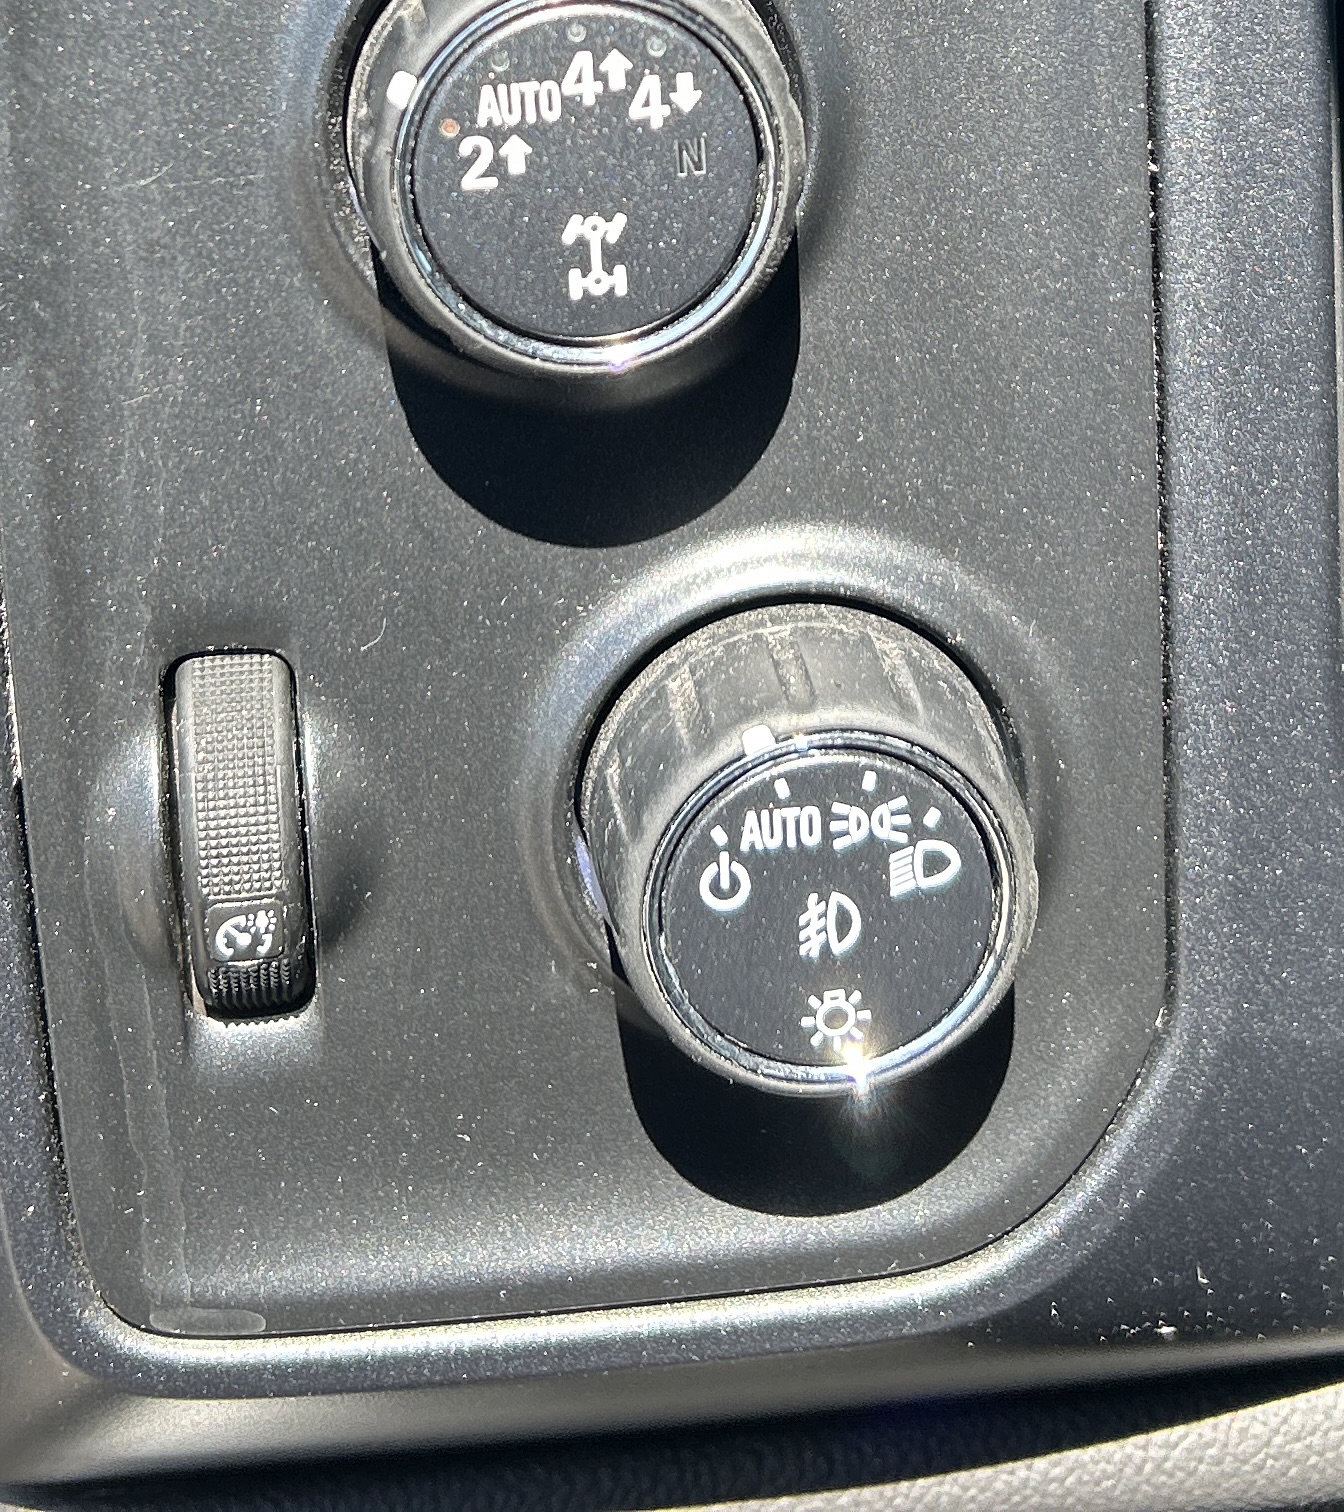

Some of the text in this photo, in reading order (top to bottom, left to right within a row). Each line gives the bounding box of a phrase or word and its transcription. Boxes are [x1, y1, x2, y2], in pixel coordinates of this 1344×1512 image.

[477, 79, 563, 128] AUTO
[561, 50, 604, 106] 4
[628, 74, 671, 129] 4
[458, 135, 499, 191] 2
[674, 137, 708, 177] N
[739, 805, 823, 852] AUTO
